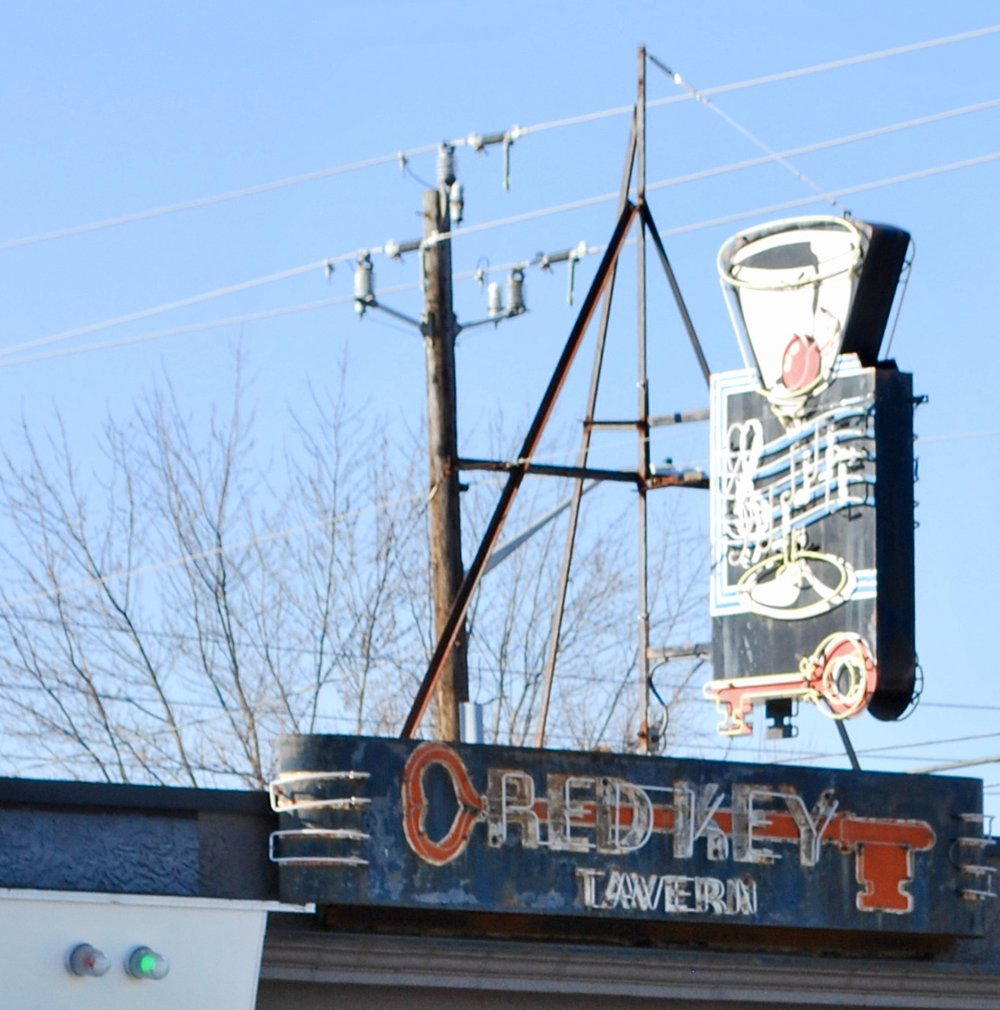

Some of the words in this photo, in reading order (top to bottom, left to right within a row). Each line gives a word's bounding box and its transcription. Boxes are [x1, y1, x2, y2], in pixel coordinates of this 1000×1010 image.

[487, 769, 652, 855] RED
[672, 780, 838, 867] KEY
[575, 863, 757, 914] TAVERN
